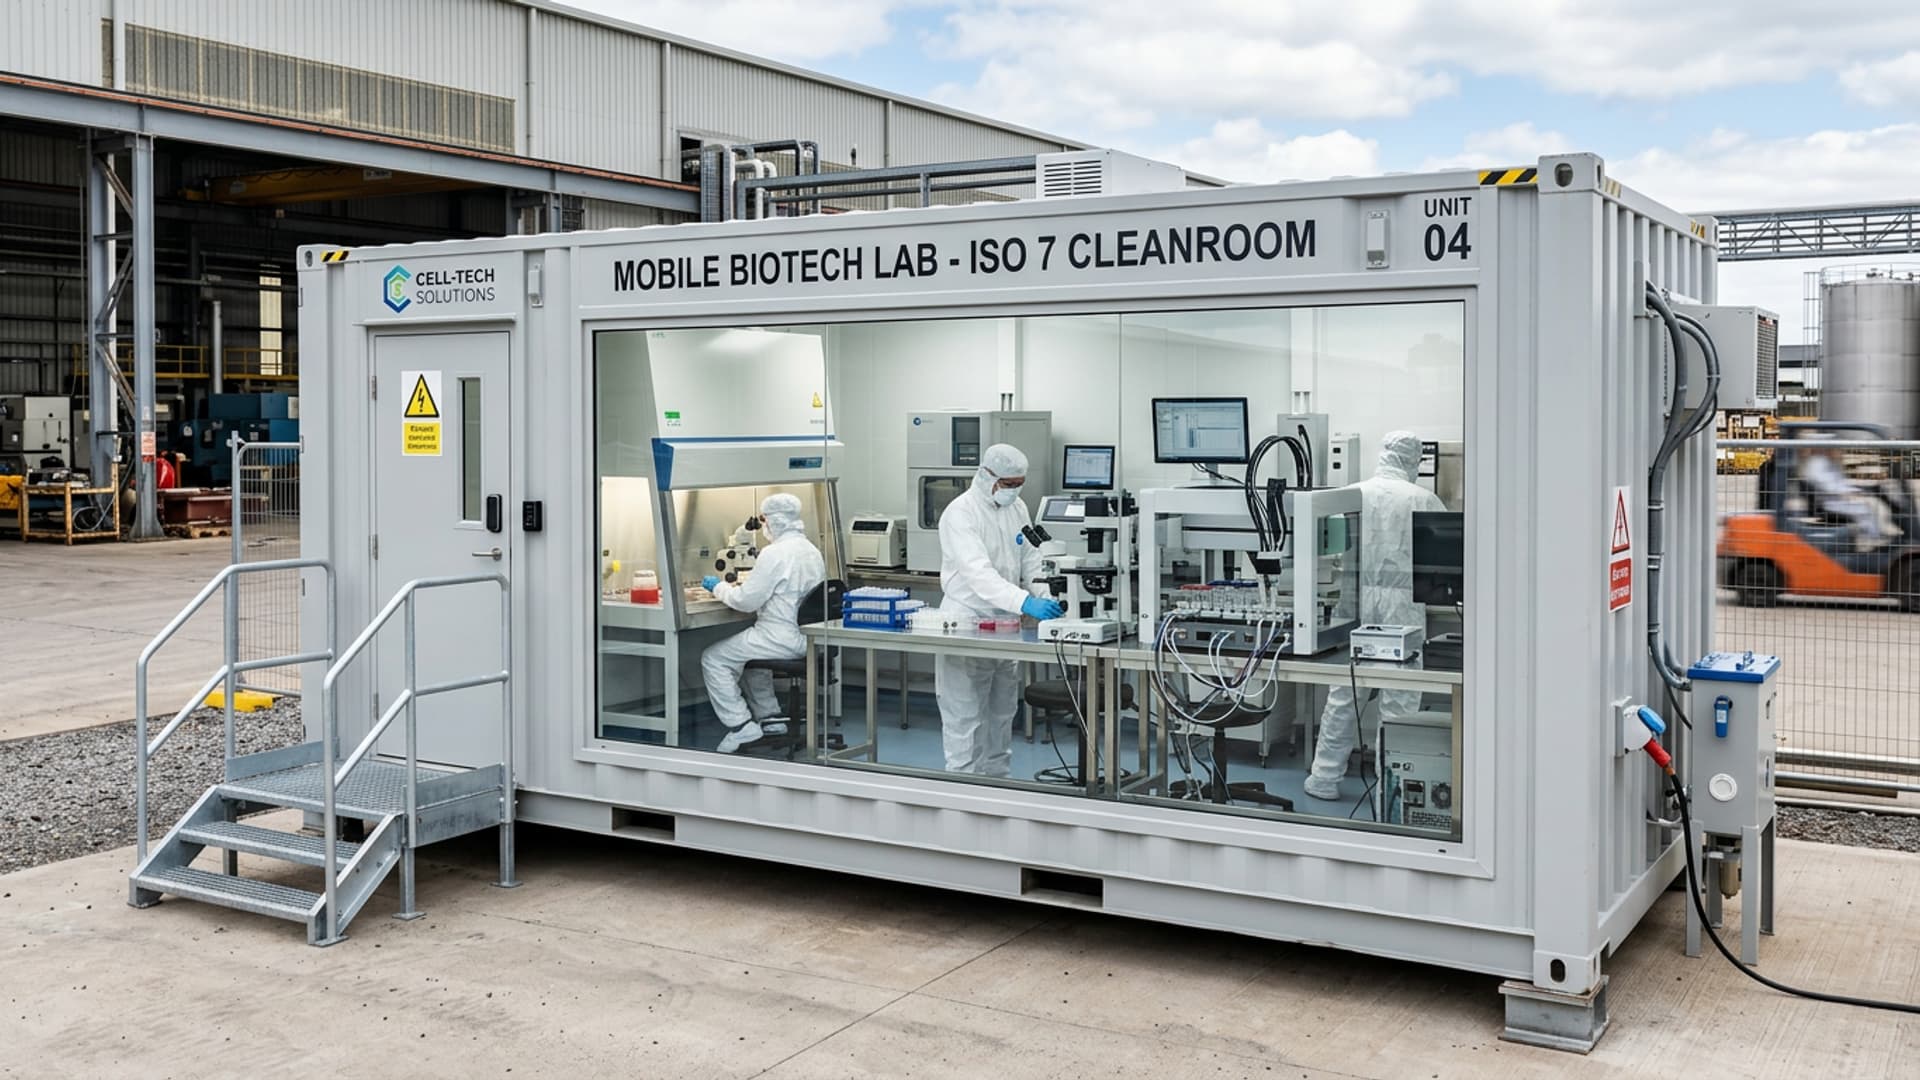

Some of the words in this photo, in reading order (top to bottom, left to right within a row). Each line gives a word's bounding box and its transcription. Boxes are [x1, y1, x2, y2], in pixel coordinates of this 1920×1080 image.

[1424, 196, 1473, 218] UNIT
[1424, 221, 1472, 262] 04
[614, 255, 721, 292] MOBILE
[730, 246, 863, 286] BIOTECH
[874, 243, 938, 279] LAB
[970, 237, 1027, 274] ISO
[1038, 235, 1057, 271] 7
[1068, 219, 1316, 270] CLEANROOM
[415, 267, 495, 286] CELL-TECH
[415, 286, 496, 304] SOLUTIONS
